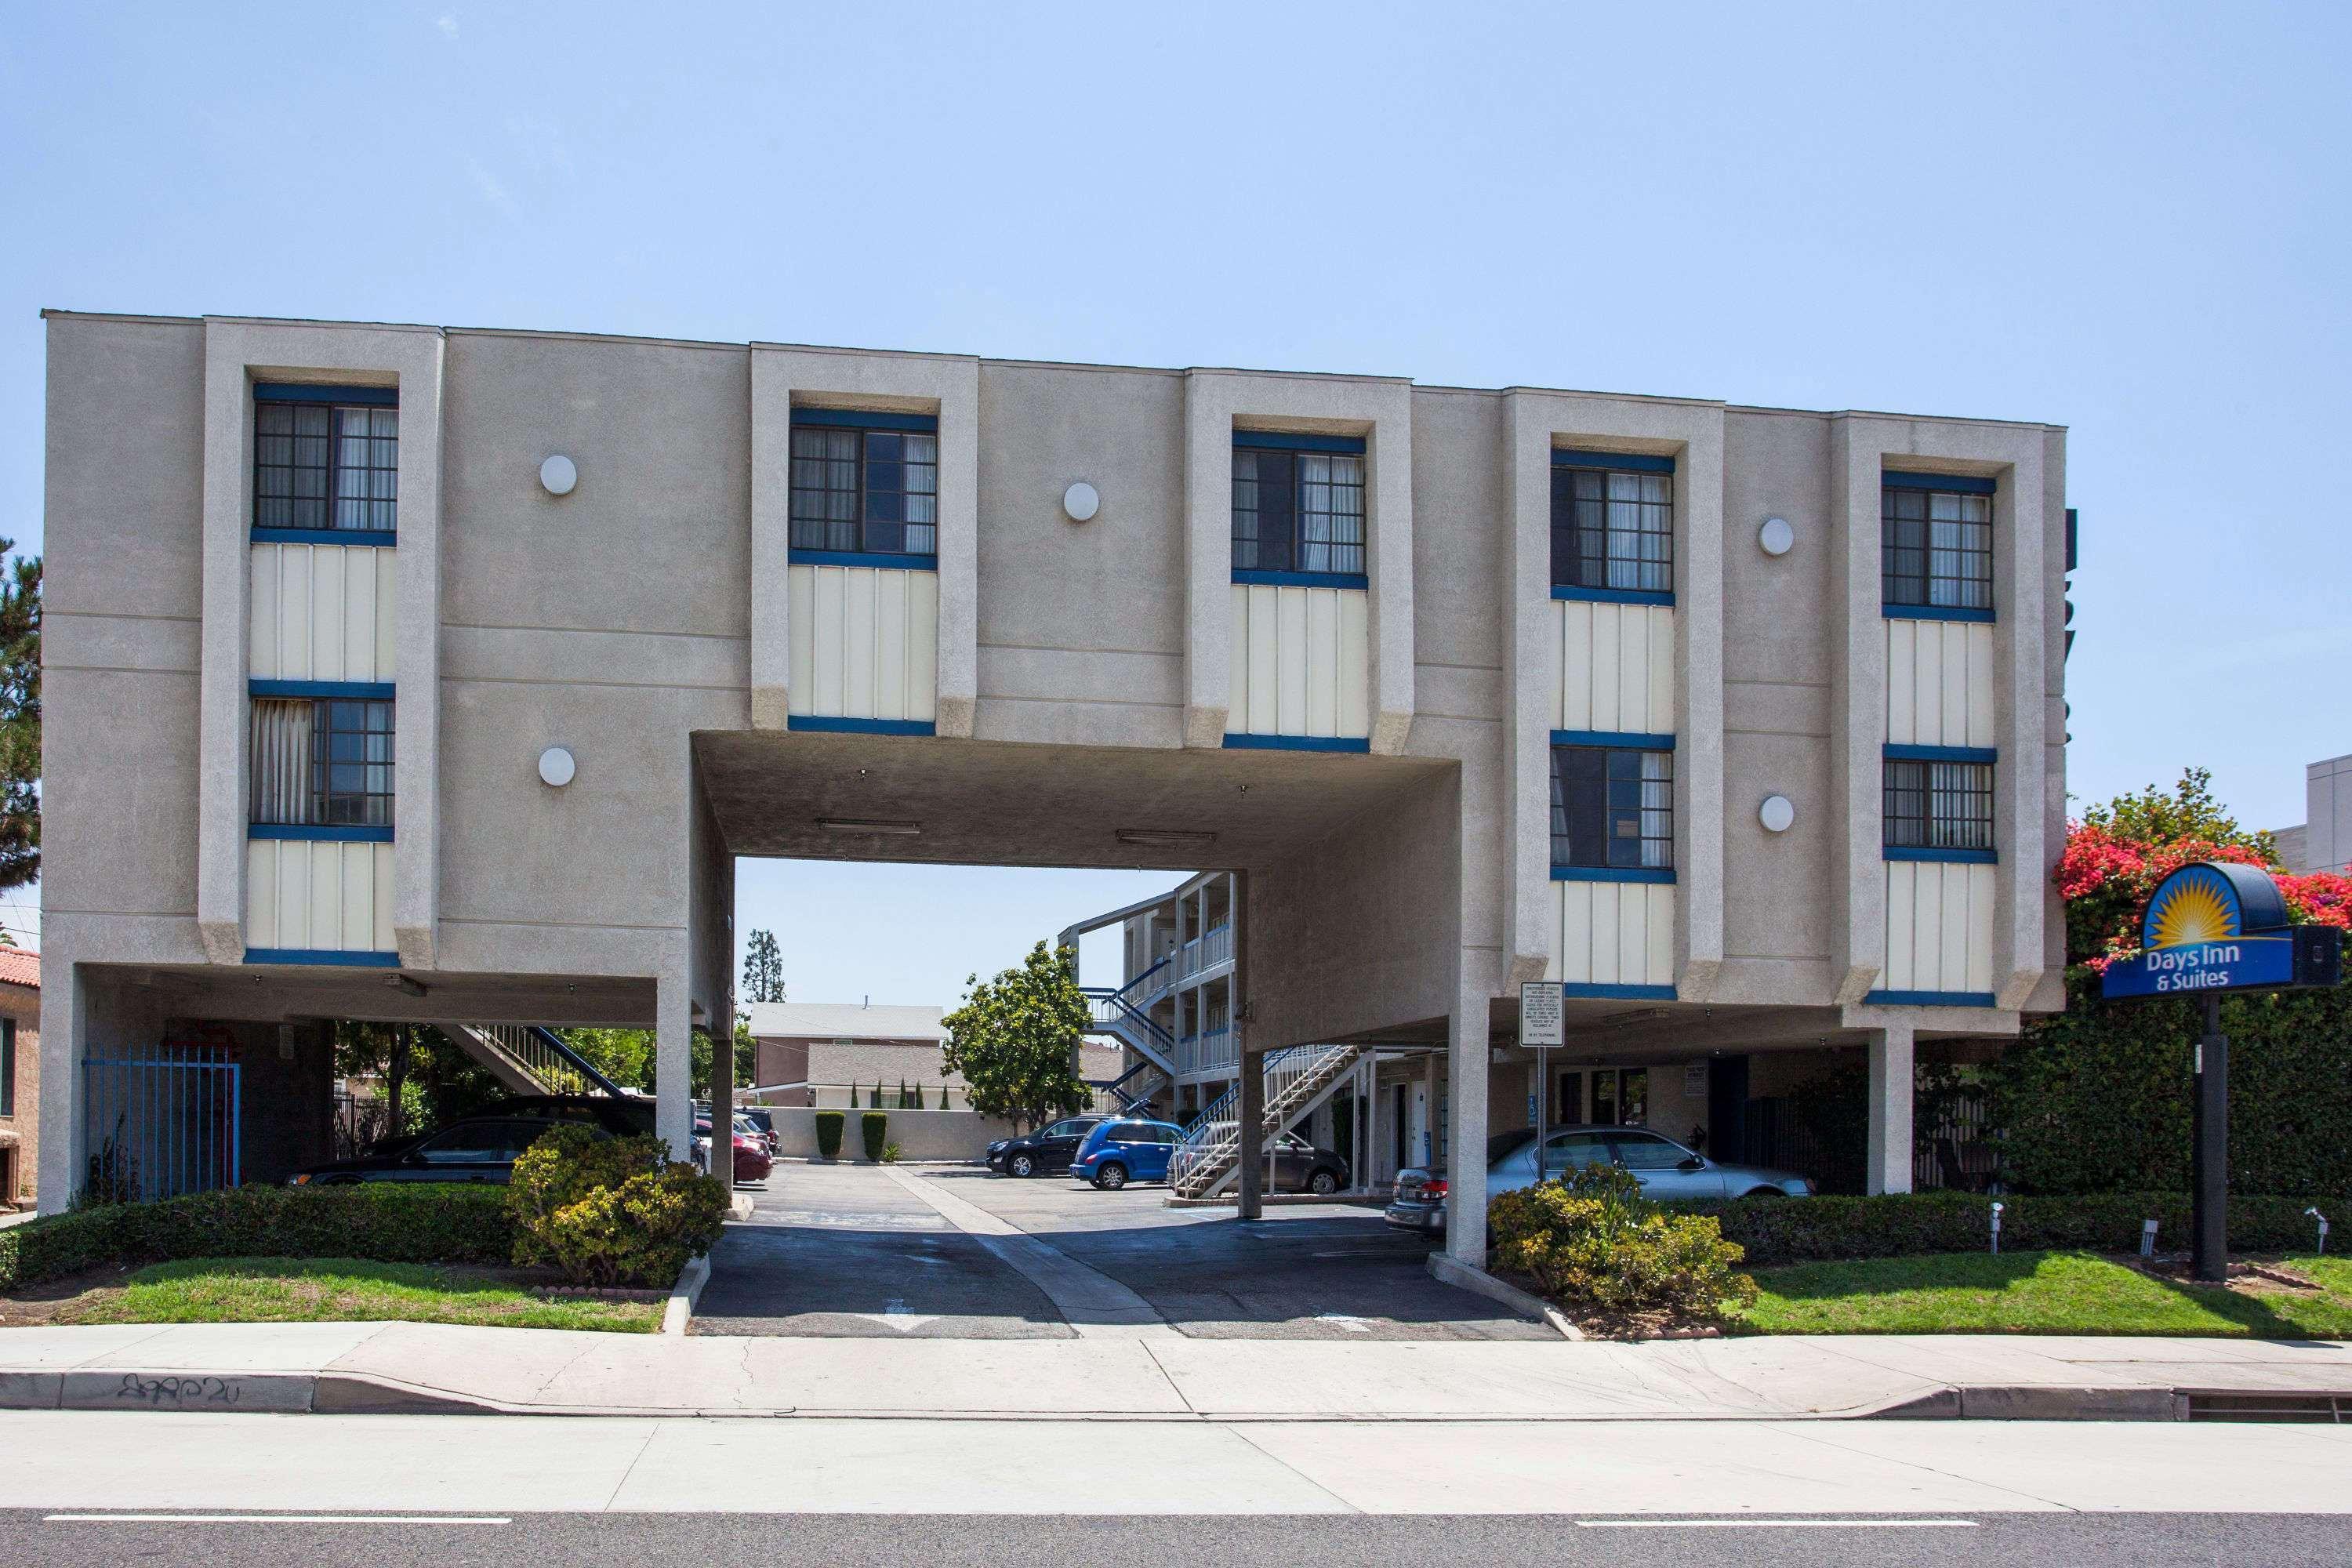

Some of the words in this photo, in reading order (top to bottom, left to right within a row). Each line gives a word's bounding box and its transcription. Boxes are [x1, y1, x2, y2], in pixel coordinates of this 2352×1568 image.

[2147, 949, 2199, 972] Days
[2202, 945, 2240, 966] Inn
[2156, 975, 2169, 991] &
[2172, 969, 2229, 990] Suites
